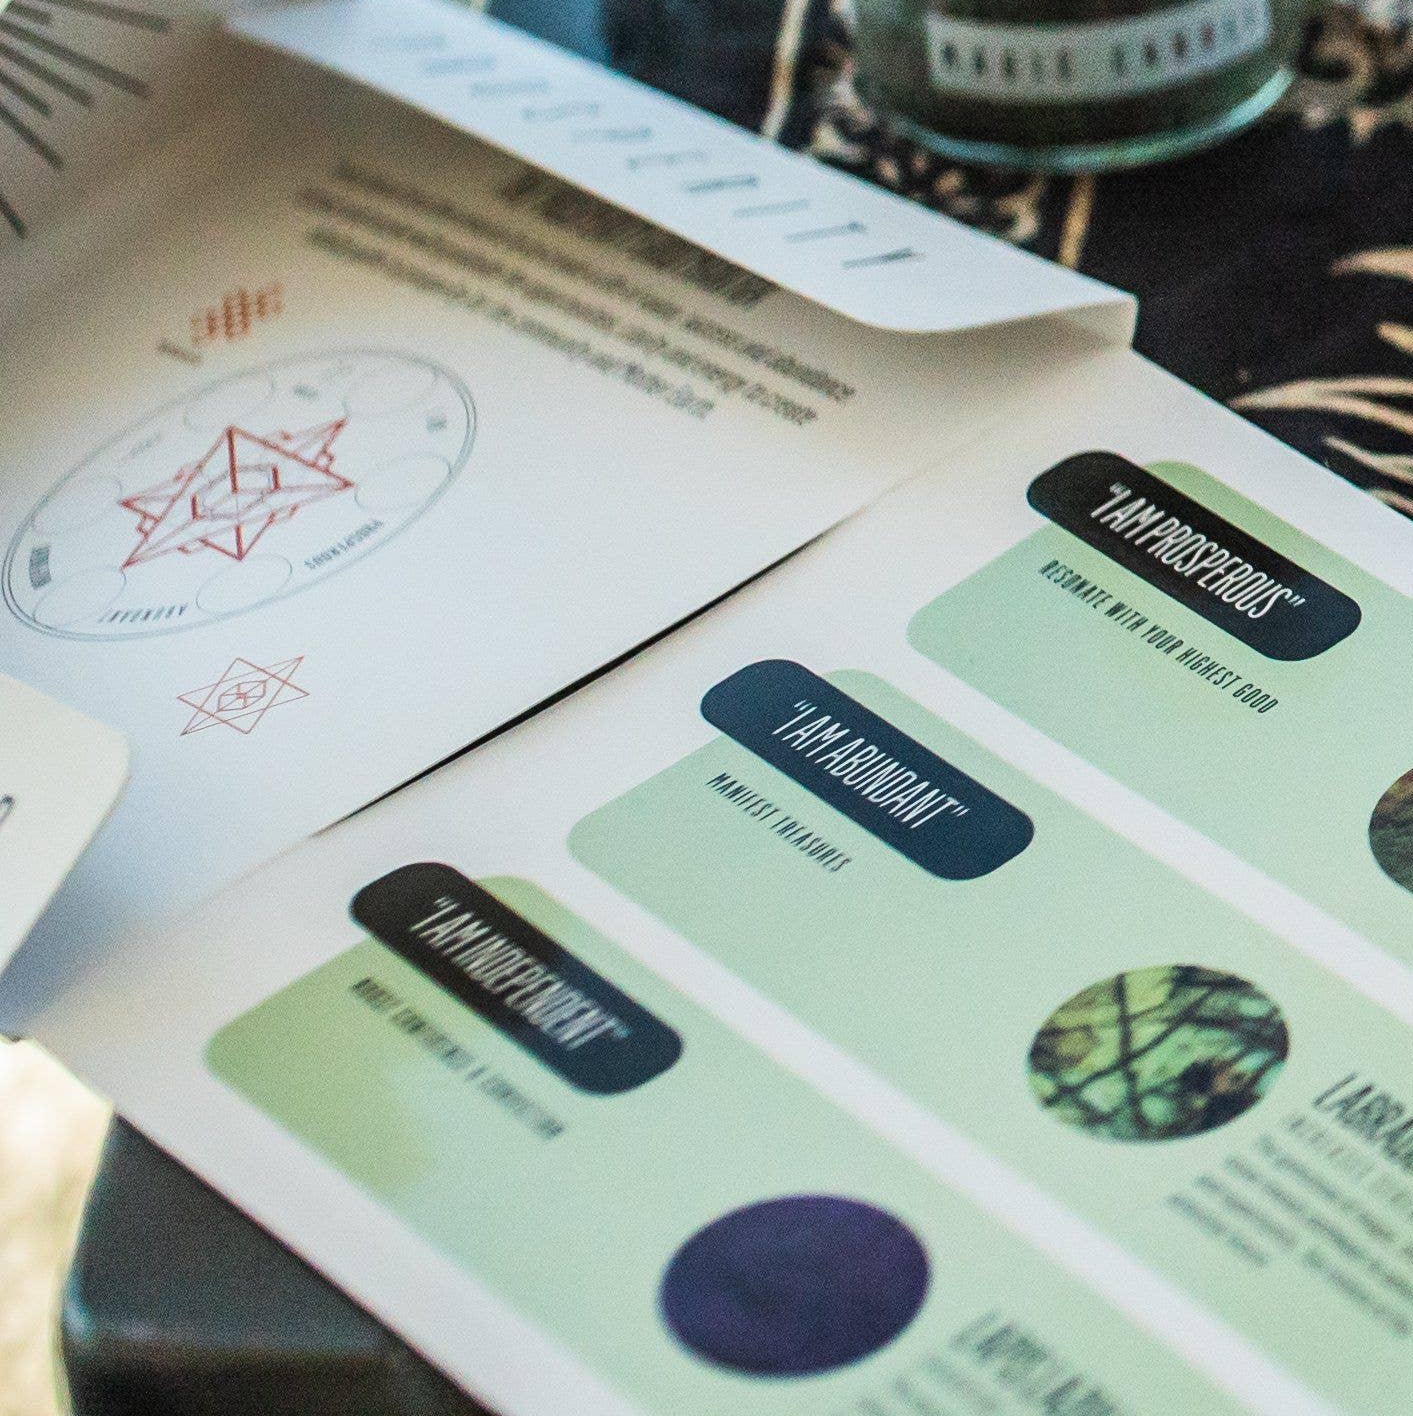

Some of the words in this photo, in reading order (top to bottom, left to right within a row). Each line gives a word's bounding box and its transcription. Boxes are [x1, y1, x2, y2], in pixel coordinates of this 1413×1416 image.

[1099, 497, 1166, 547] AM
[1038, 559, 1114, 610] RESONATE
[1104, 600, 1149, 633] WITH
[1140, 623, 1185, 655] YOUR
[1175, 646, 1243, 691] HIGHEST
[1231, 683, 1279, 714] GOOD
[782, 714, 851, 758] AM
[705, 771, 781, 823] MANIFEST
[769, 815, 853, 873] TREASURES
[417, 910, 493, 957] AM
